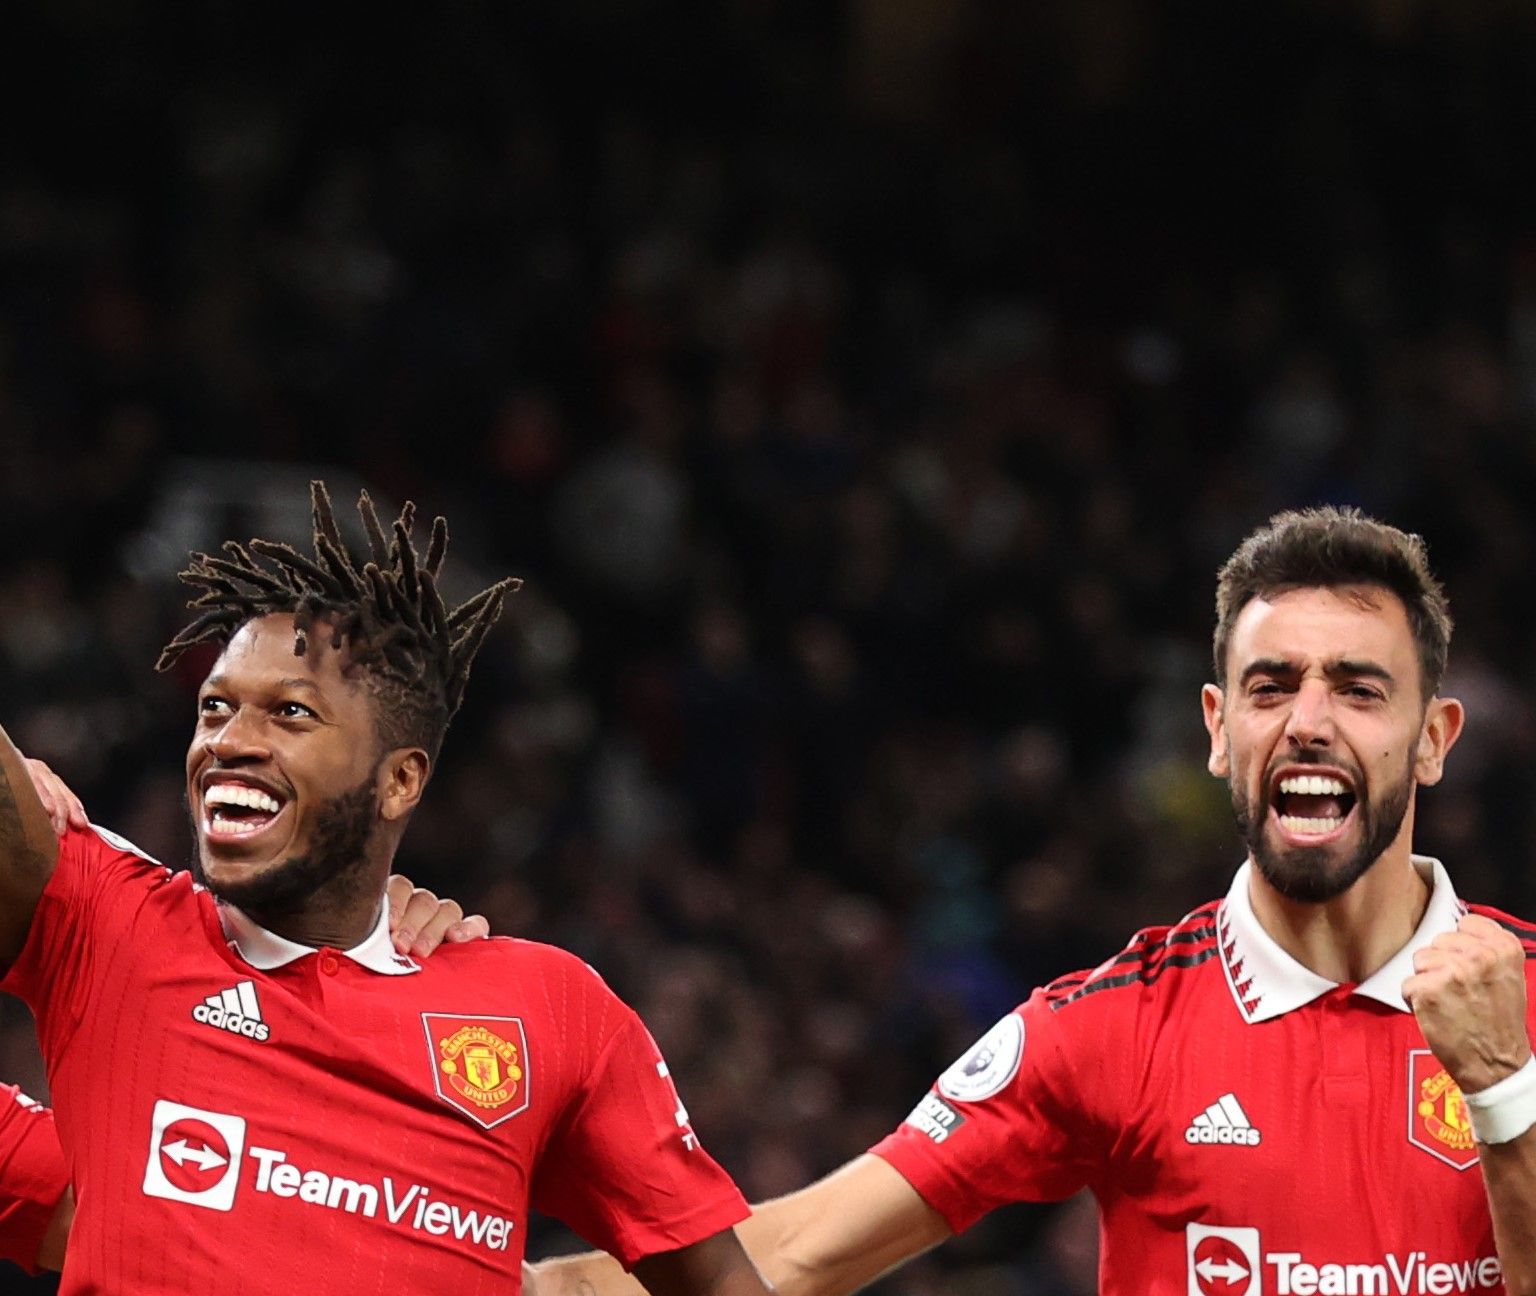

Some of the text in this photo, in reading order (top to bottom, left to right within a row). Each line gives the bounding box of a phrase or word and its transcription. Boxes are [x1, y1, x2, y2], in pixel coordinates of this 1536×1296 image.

[192, 1004, 270, 1042] adidas
[446, 1031, 512, 1058] MANCHESTER
[464, 1085, 508, 1101] UNITED
[1185, 1124, 1261, 1146] adidas
[248, 1145, 515, 1252] TeamViewer
[1267, 1251, 1505, 1296] TeamViewe
